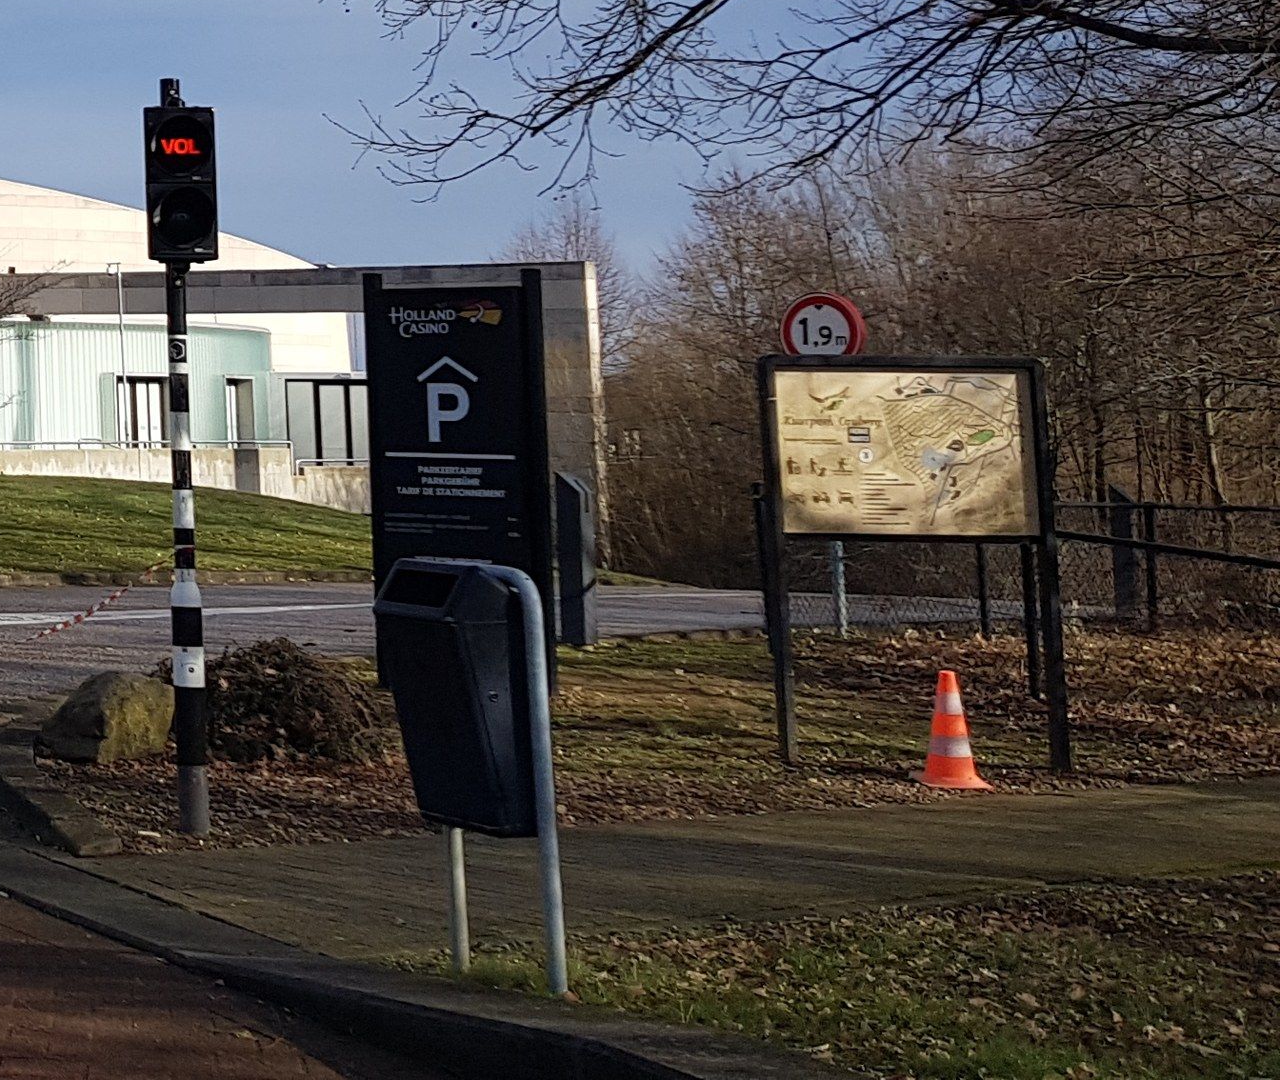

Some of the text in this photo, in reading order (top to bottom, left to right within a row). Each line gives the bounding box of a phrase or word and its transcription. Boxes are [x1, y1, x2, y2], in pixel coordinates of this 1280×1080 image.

[160, 138, 201, 155] VOL
[388, 306, 457, 325] HOLLAND
[399, 321, 450, 337] CASINO
[426, 382, 470, 443] P
